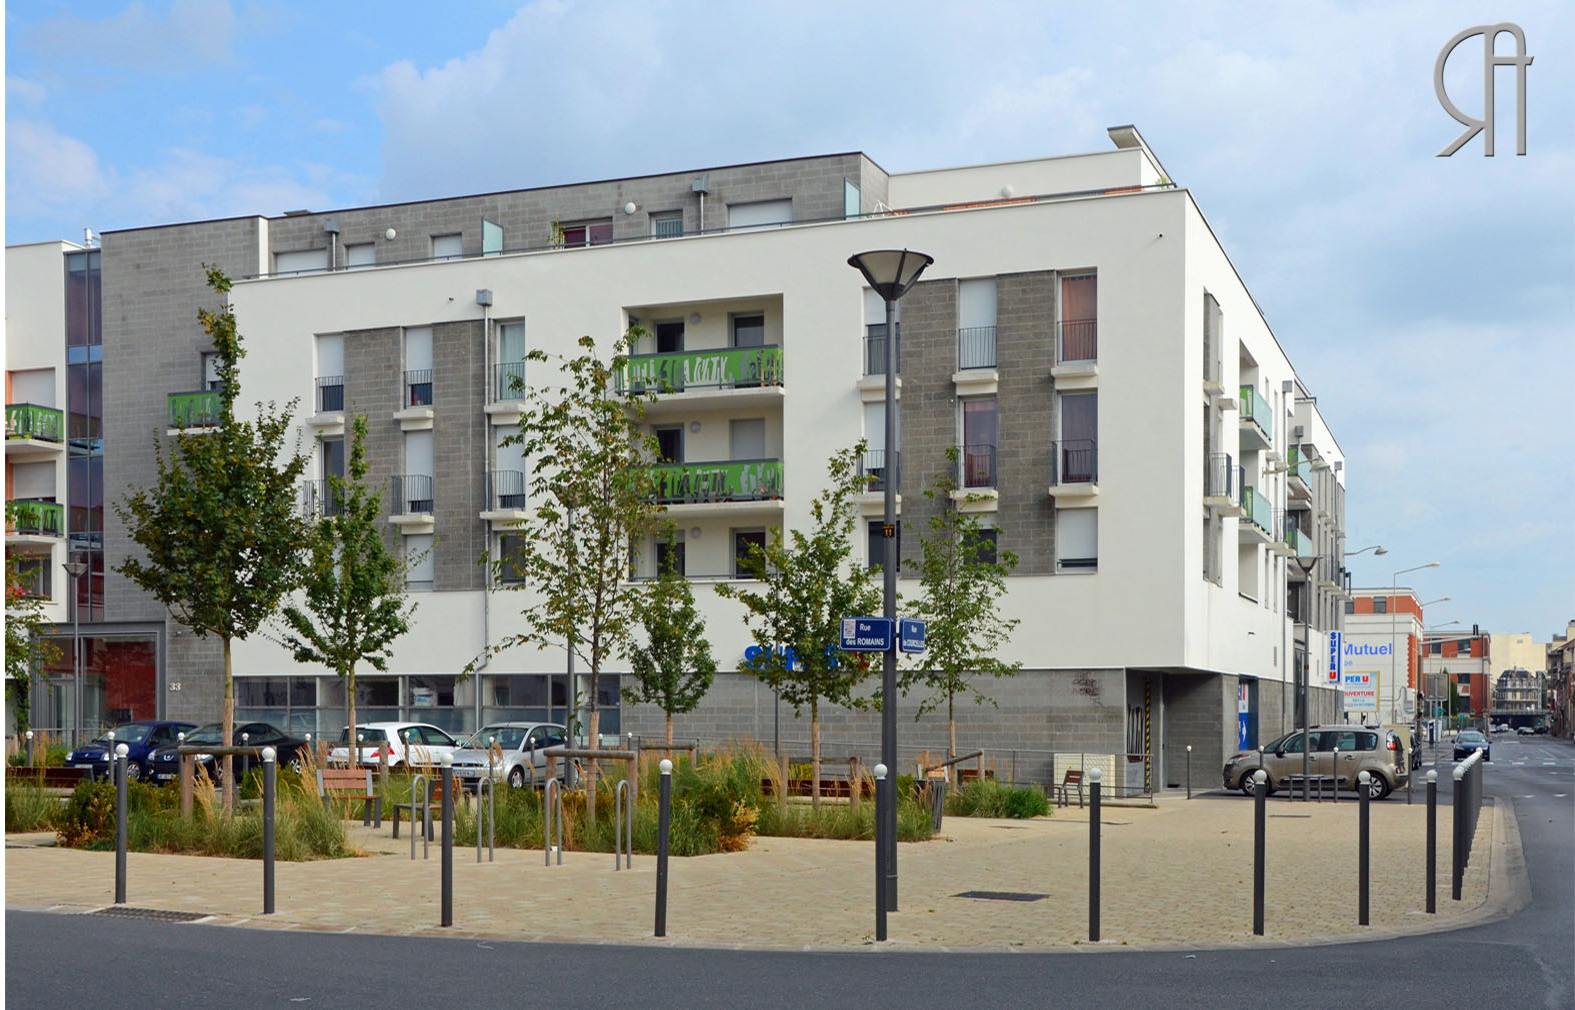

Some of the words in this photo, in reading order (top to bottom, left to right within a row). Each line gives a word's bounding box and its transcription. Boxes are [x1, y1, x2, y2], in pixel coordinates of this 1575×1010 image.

[859, 623, 871, 632] Rue
[845, 638, 857, 646] des
[857, 637, 885, 646] ROMAINS
[169, 682, 182, 691] 33
